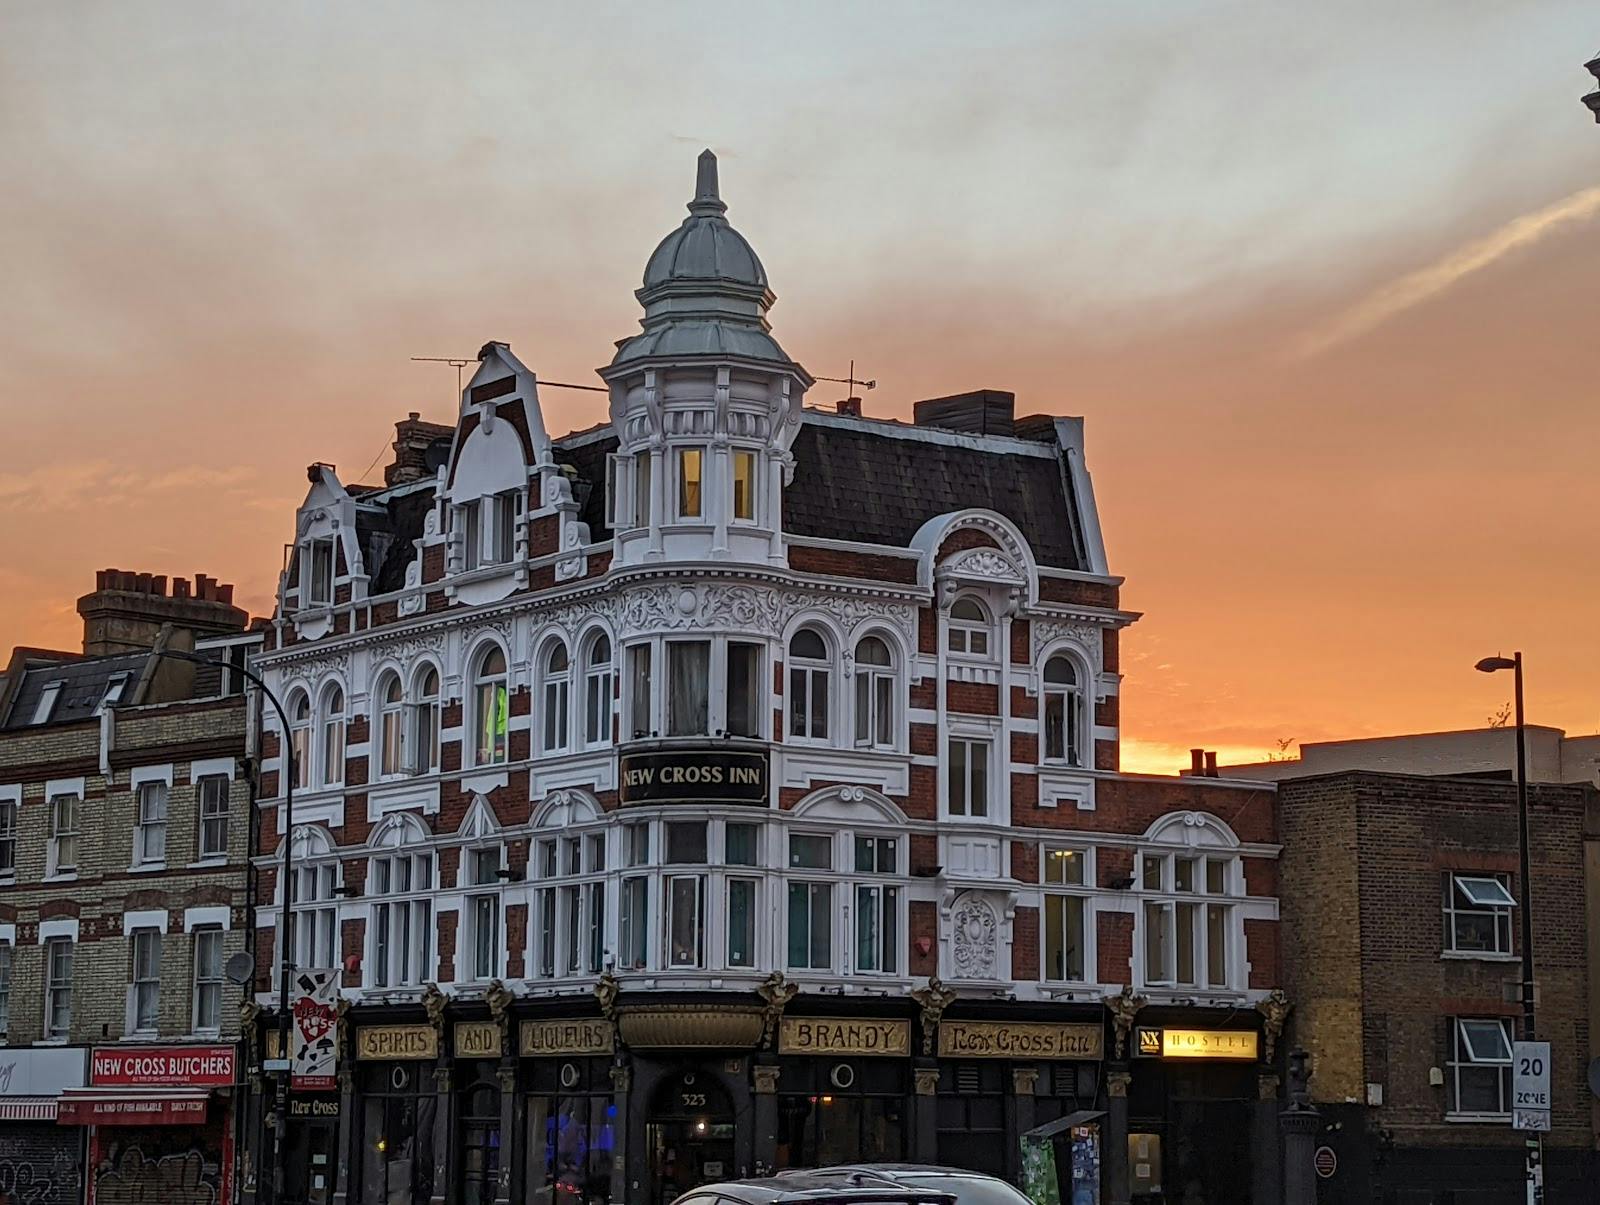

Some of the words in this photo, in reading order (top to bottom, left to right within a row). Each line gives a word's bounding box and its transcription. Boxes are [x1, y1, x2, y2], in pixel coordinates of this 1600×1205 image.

[624, 767, 654, 787] NEW
[660, 766, 723, 783] CROSS
[729, 767, 760, 785] INN
[296, 1017, 335, 1032] CROSS
[368, 1031, 427, 1054] SPIRITS
[464, 1028, 493, 1051] AND
[532, 1025, 604, 1049] LIQUEURS
[798, 1024, 895, 1048] BRANDY
[997, 1028, 1054, 1051] Cross
[1059, 1030, 1090, 1053] Inn
[1140, 1031, 1160, 1046] NX
[1172, 1034, 1249, 1048] HOSTEL
[94, 1058, 122, 1075] NEW
[125, 1057, 165, 1075] CROSS
[168, 1057, 231, 1075] BUTCHERS
[1520, 1058, 1543, 1076] 20
[682, 1094, 706, 1106] 323
[1517, 1092, 1546, 1104] ZONE
[313, 1100, 339, 1115] Cross
